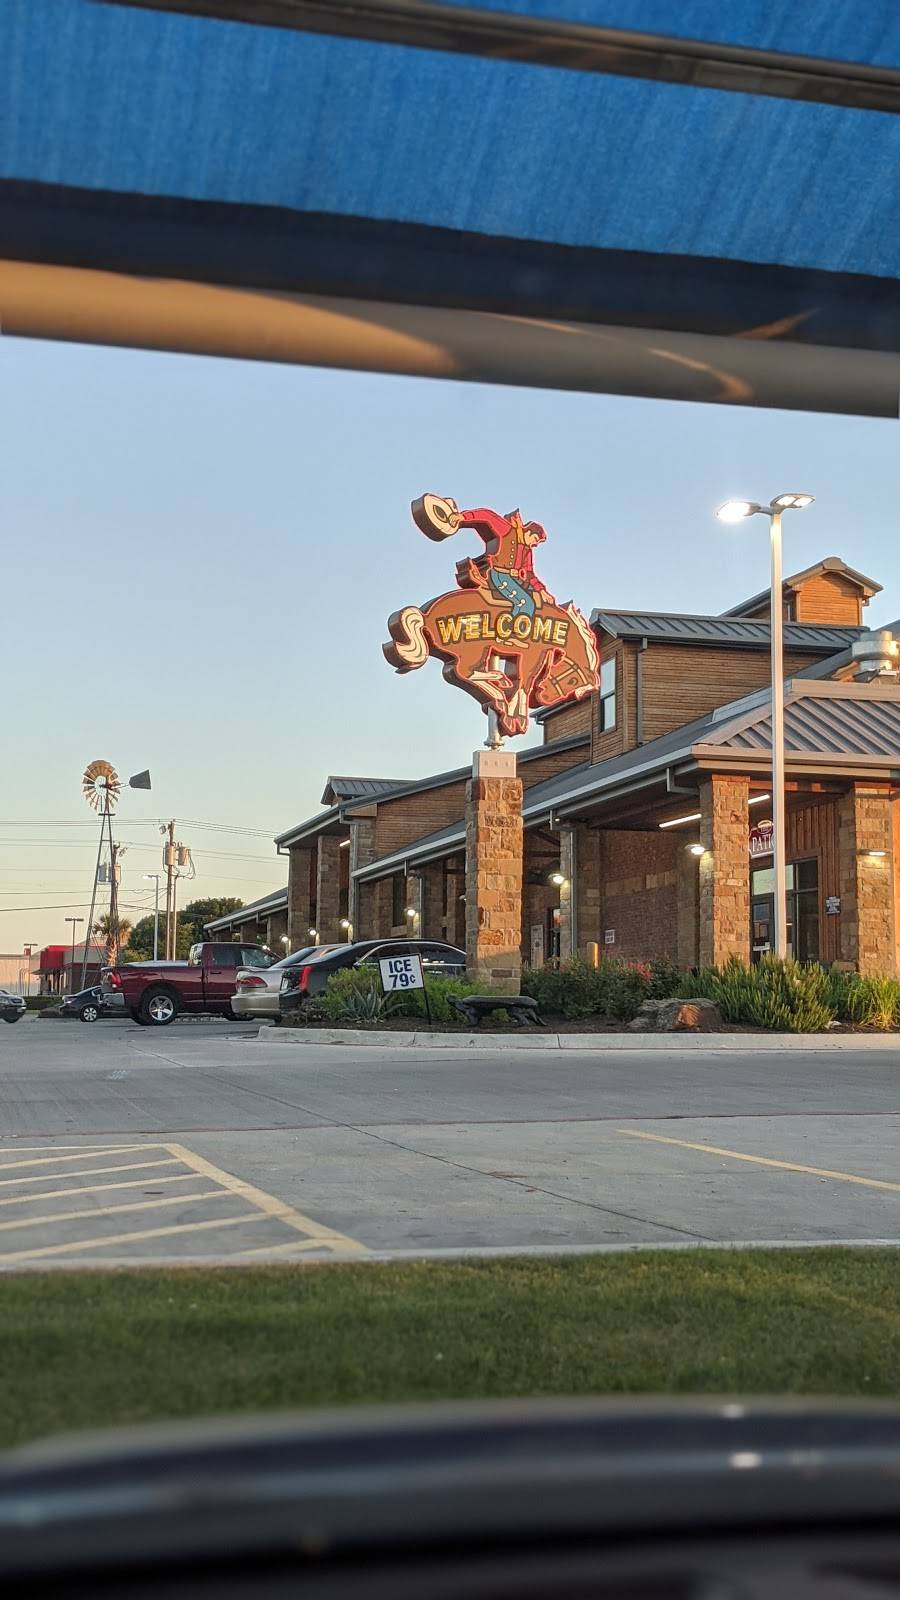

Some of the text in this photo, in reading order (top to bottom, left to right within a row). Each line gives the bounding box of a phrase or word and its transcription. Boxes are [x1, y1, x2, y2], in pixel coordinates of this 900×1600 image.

[437, 612, 569, 645] WELCOME
[752, 833, 775, 852] PATI
[388, 959, 412, 973] ICE
